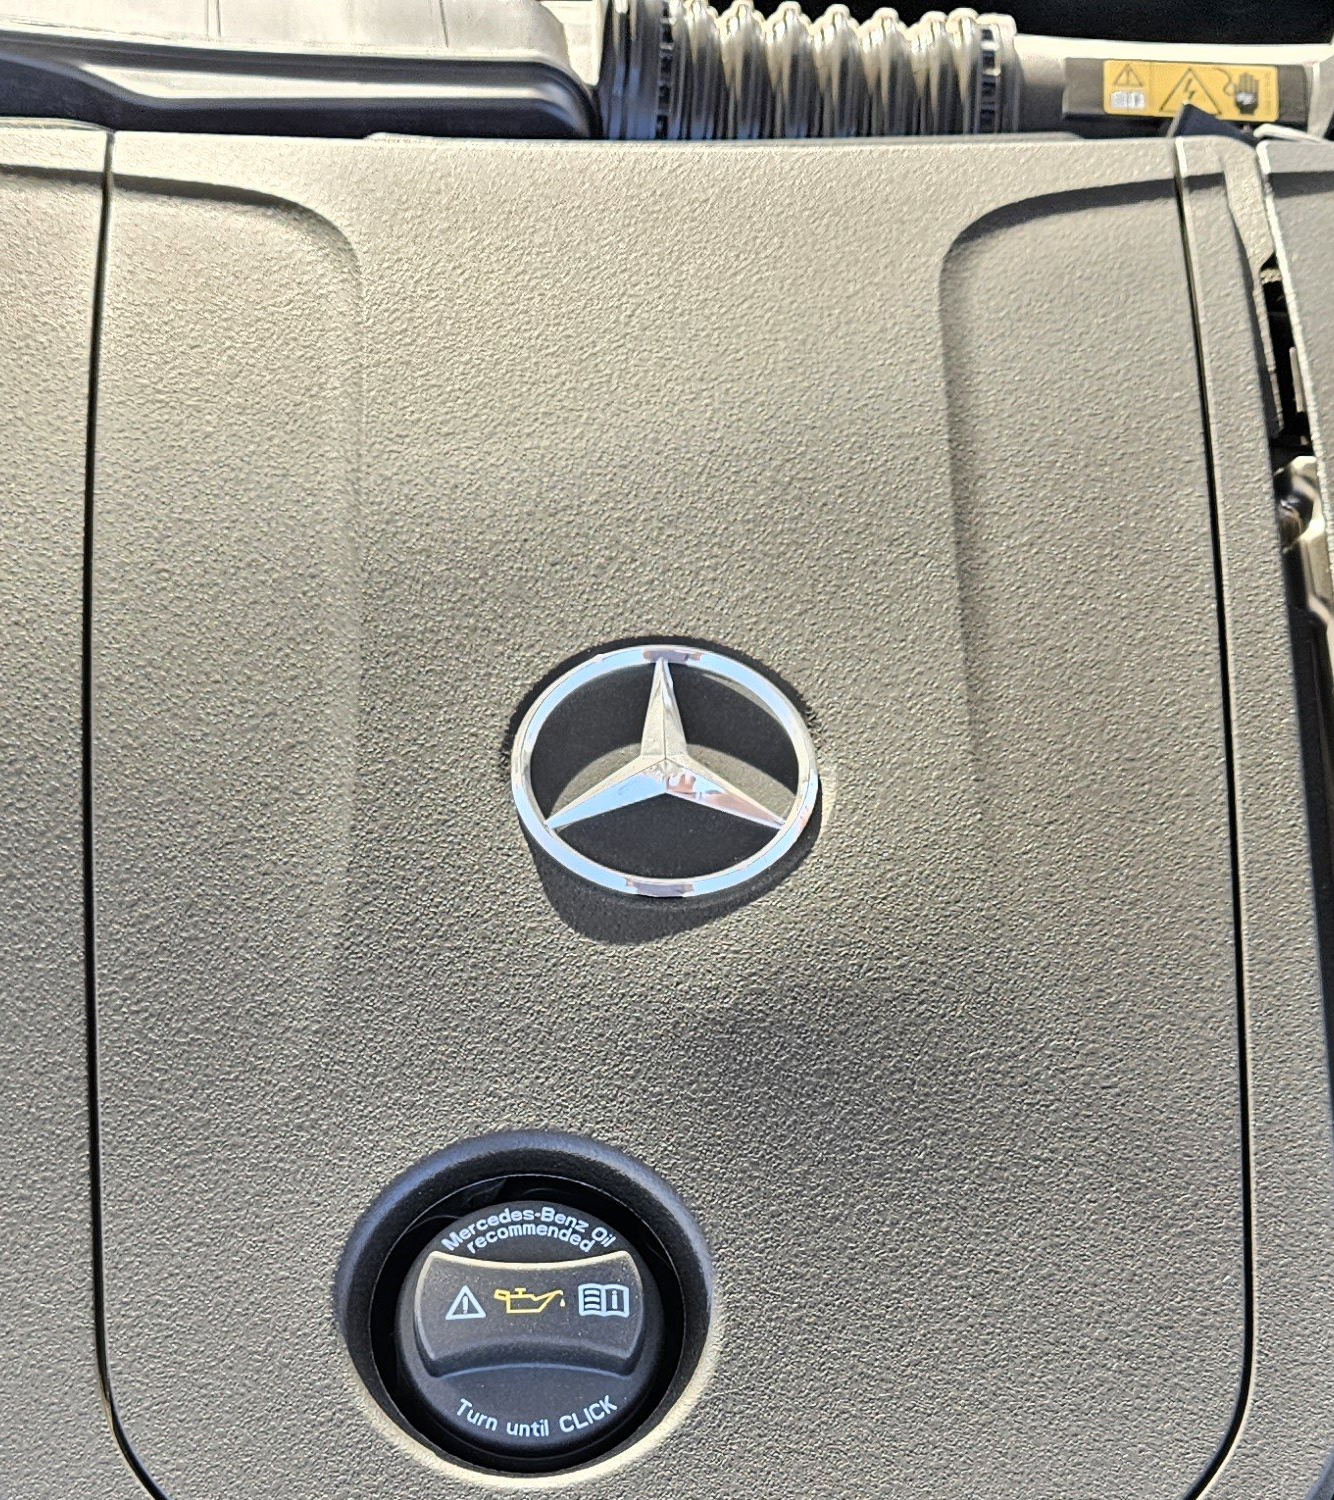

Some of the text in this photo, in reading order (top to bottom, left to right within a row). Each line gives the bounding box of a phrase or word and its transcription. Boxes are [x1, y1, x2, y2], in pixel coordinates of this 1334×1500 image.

[441, 1207, 617, 1251] Mercedes-Benz Oil
[467, 1222, 594, 1254] recommended
[456, 1394, 619, 1437] Turn until CLICK
